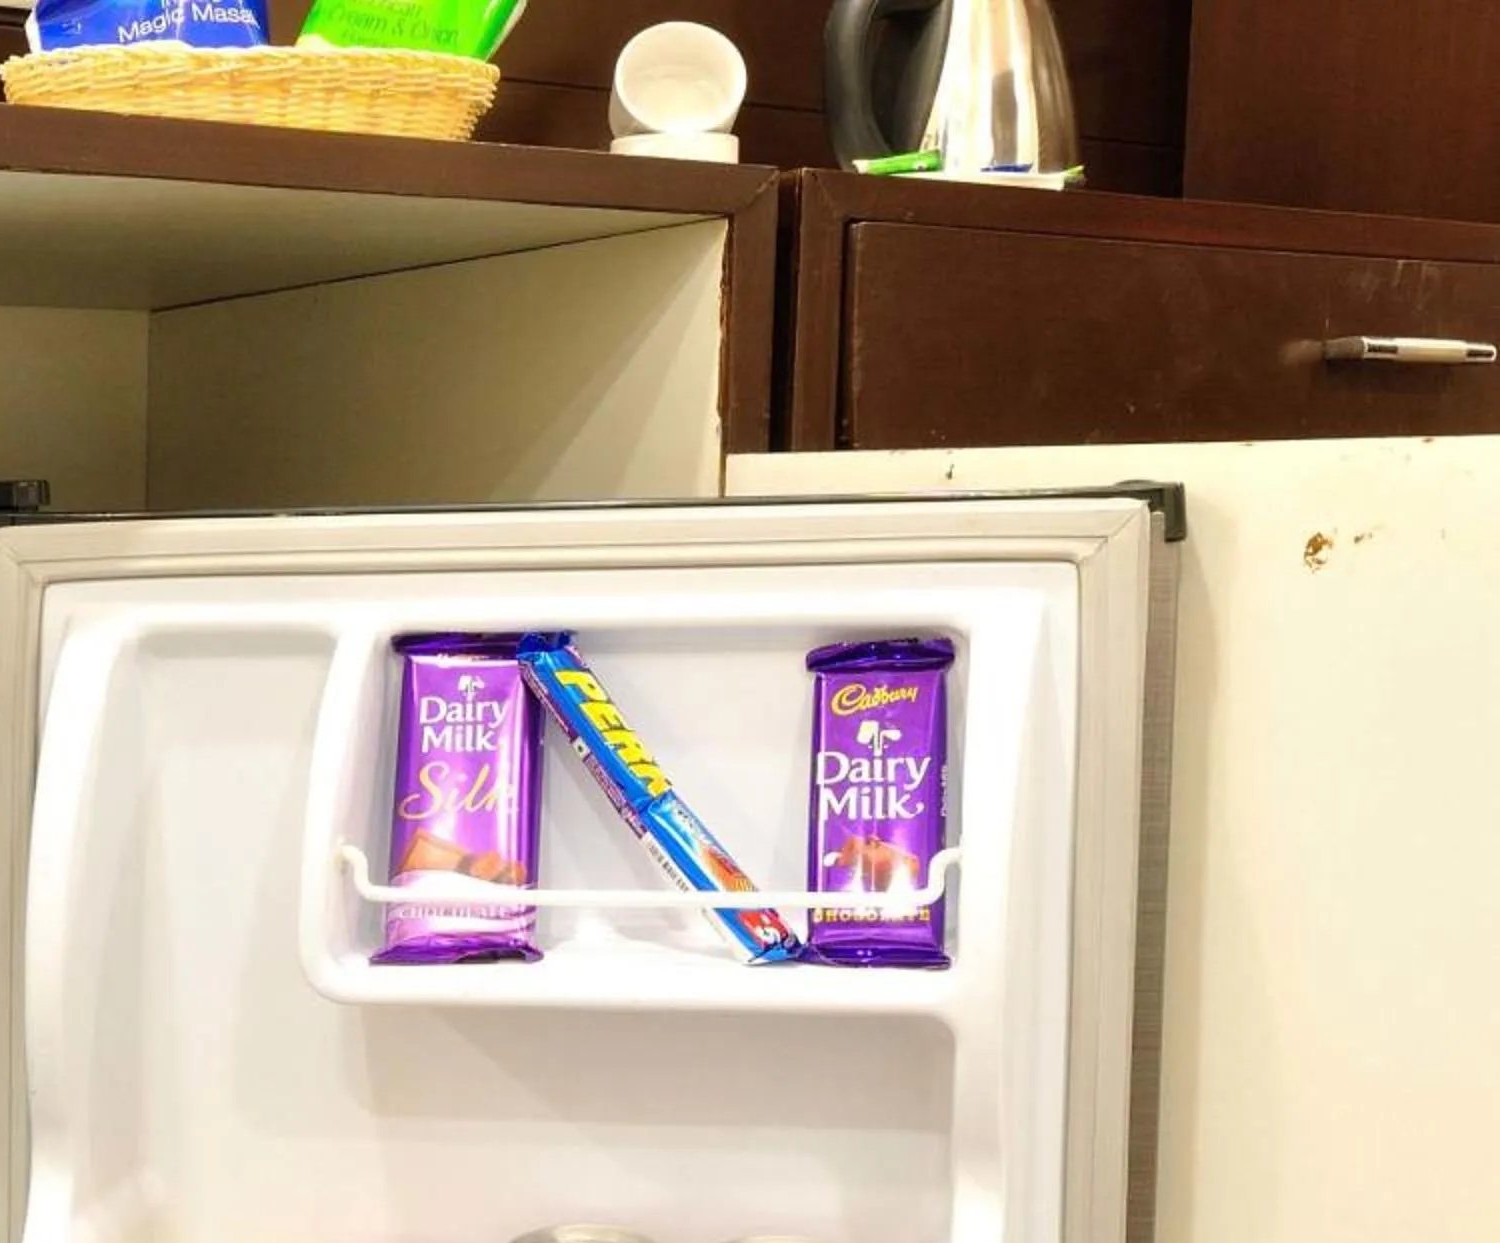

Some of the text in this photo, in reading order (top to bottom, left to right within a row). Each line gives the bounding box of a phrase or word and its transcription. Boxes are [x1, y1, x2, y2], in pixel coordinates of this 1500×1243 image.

[117, 7, 185, 43] Magic
[419, 696, 504, 729] Dairy
[831, 683, 918, 715] Cadbury
[420, 724, 498, 753] Milk
[553, 669, 673, 797] PERK
[816, 751, 932, 791] Dairy
[819, 785, 925, 820] Milk
